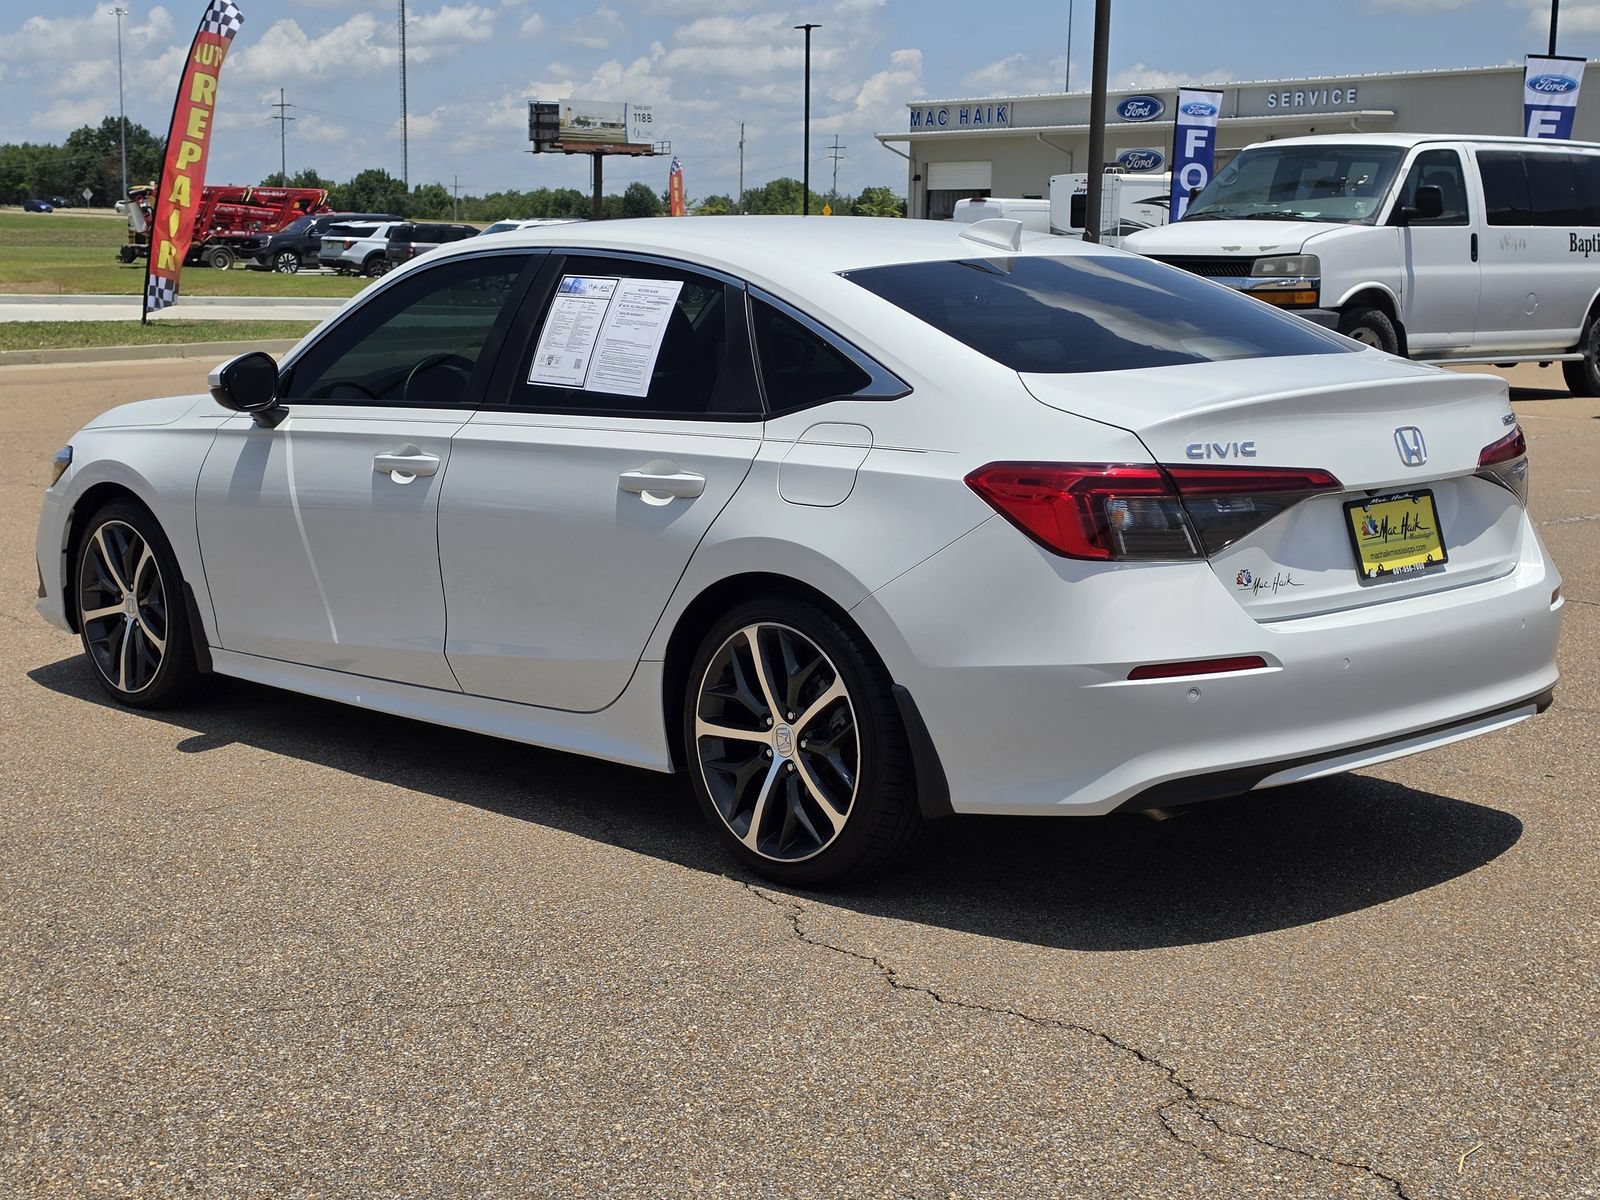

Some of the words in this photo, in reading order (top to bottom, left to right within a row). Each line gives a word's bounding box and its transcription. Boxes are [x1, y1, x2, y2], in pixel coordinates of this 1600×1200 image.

[1535, 77, 1569, 92] Ford
[1267, 88, 1357, 108] SERVICE
[910, 109, 948, 128] MAC
[959, 105, 1007, 125] HAIK
[1124, 101, 1151, 117] Ford
[1187, 101, 1211, 116] Ford
[1126, 150, 1154, 169] Ford
[157, 71, 217, 272] REPAIR
[1186, 441, 1257, 459] CIVIC
[1379, 514, 1401, 543] Mac
[1401, 511, 1430, 540] Haik
[1370, 544, 1427, 560] machaikmississippi.com
[1250, 577, 1271, 596] Mac
[1271, 572, 1304, 594] Haik
